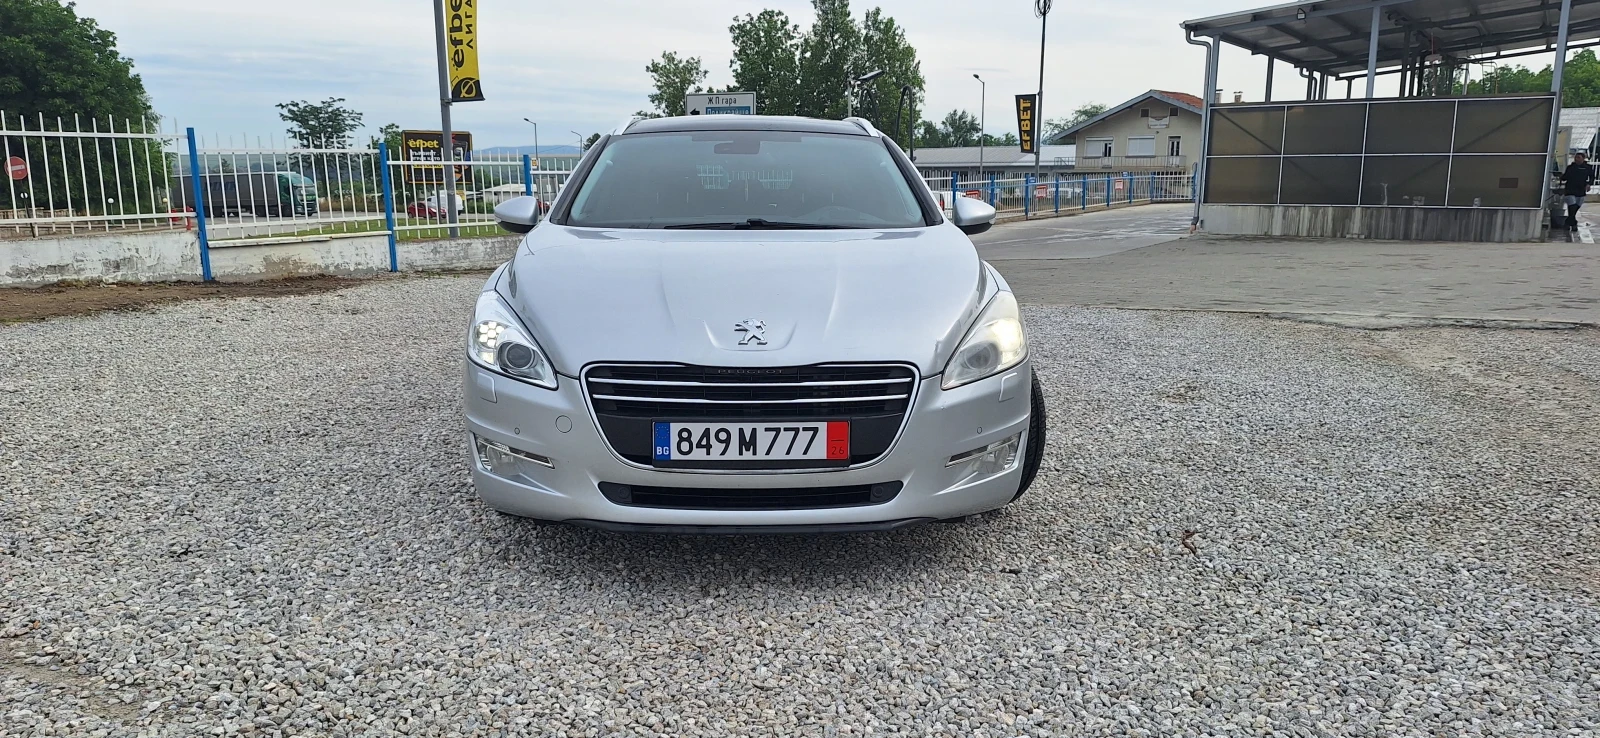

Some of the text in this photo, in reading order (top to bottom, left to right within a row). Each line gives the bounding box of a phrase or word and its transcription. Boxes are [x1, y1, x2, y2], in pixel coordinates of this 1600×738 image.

[721, 97, 737, 106] гара
[1020, 98, 1031, 150] EFBET
[656, 446, 669, 455] BG
[831, 446, 845, 455] 26
